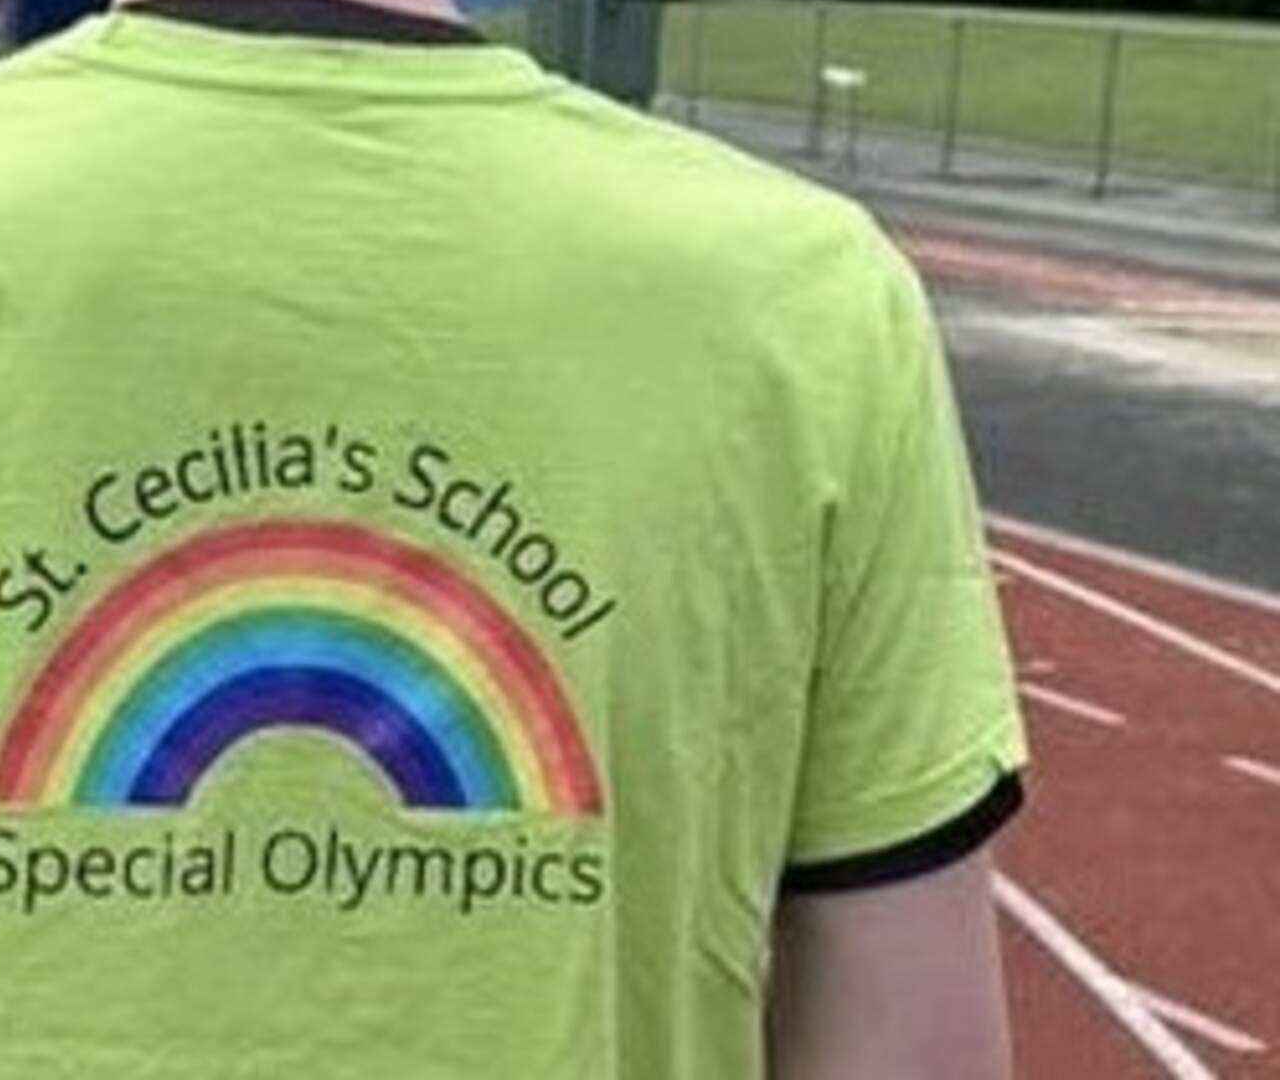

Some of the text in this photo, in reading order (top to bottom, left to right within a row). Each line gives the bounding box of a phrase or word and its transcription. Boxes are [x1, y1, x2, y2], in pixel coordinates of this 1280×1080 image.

[84, 421, 378, 543] Cecilia's
[393, 443, 617, 641] School
[261, 829, 604, 911] Olympics
